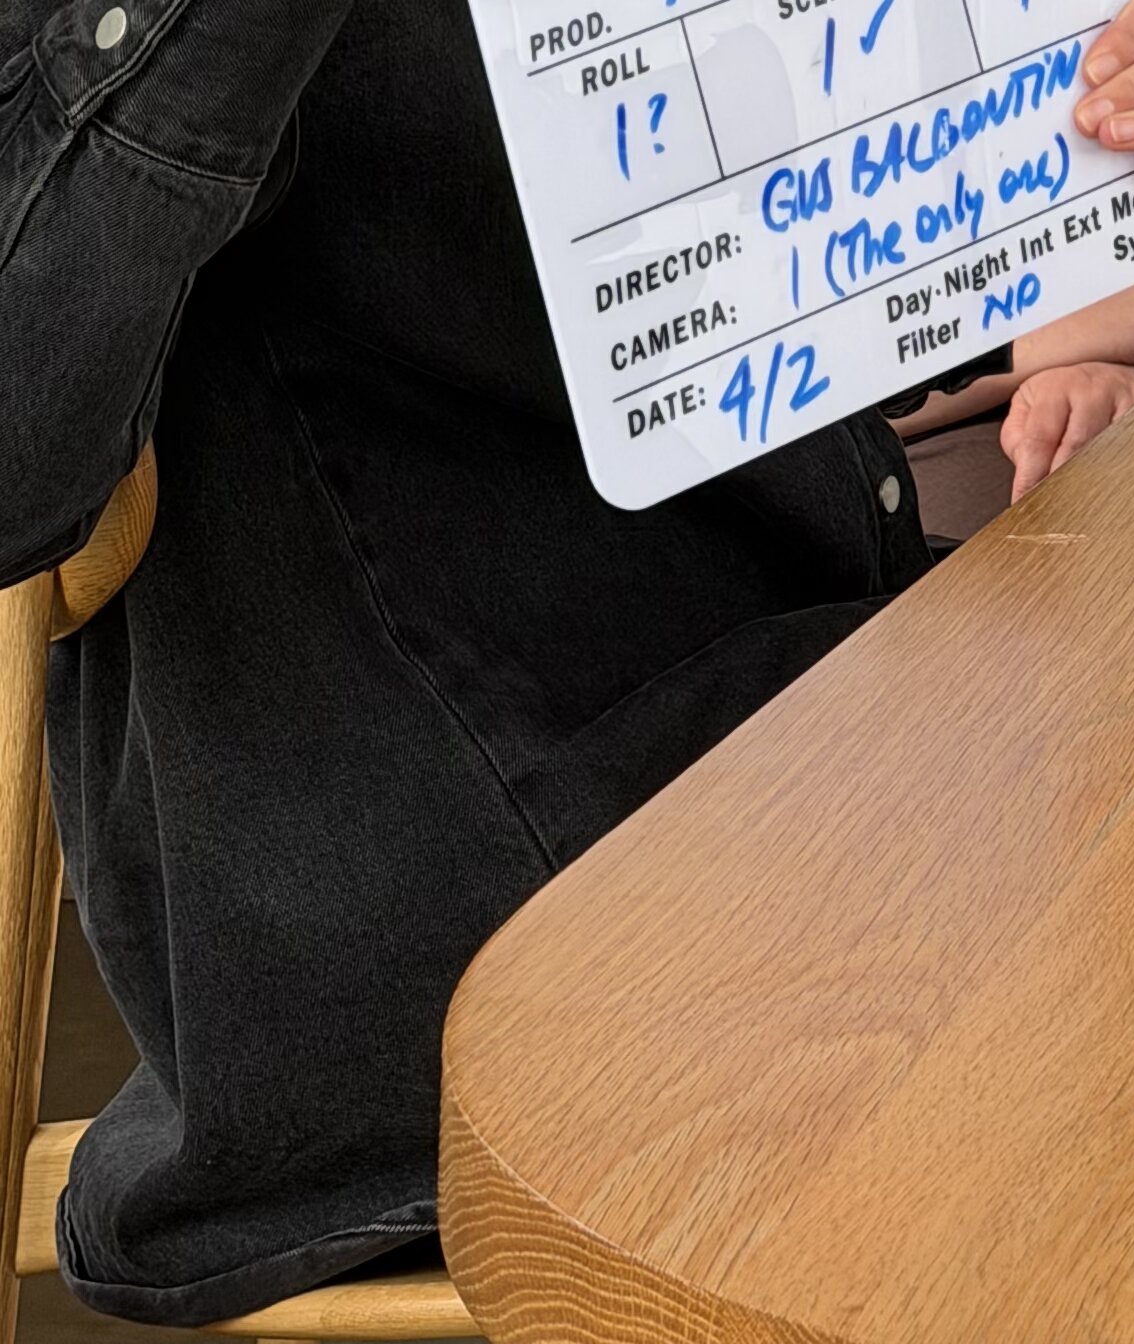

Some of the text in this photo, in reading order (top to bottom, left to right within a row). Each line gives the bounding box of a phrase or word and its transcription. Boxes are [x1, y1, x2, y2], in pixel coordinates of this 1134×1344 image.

[528, 11, 613, 63] PROD.
[580, 46, 651, 97] ROLL
[761, 157, 833, 233] GUS
[824, 217, 906, 298] (The
[915, 170, 985, 241] only
[1019, 227, 1055, 265] Int
[1062, 206, 1103, 245] Ext
[594, 231, 743, 314] DIRECTOR:
[609, 300, 738, 372] CAMERA:
[896, 316, 962, 365] Filter
[626, 384, 707, 440] DATE:
[718, 341, 831, 445] 4/2
